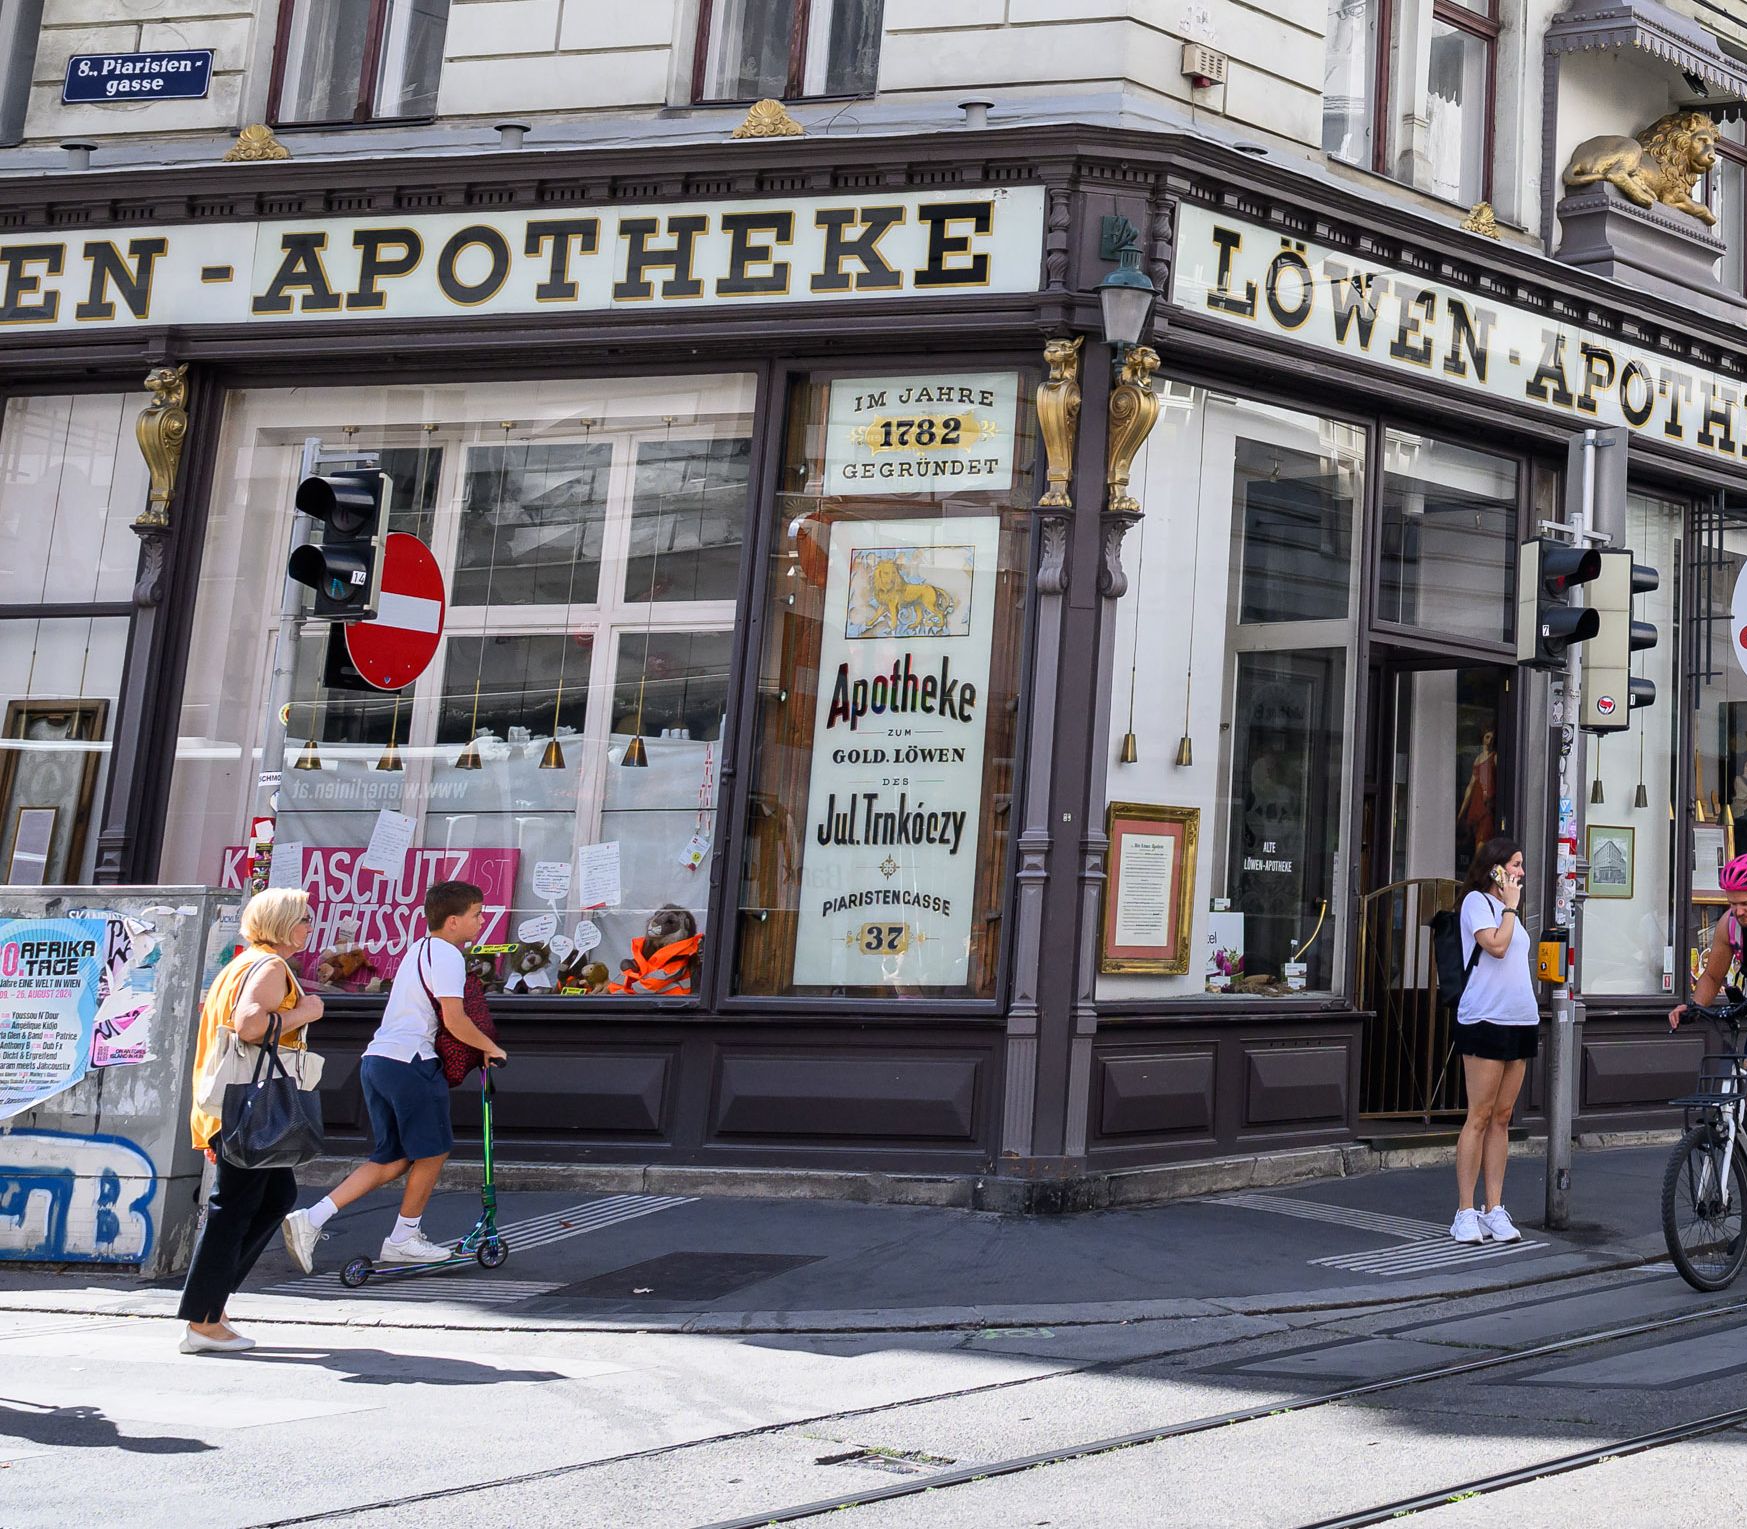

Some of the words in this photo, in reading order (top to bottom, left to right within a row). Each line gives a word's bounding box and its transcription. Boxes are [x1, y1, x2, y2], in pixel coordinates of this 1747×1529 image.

[106, 78, 164, 96] gasse
[854, 391, 887, 412] IM
[898, 386, 994, 407] JAHRE
[879, 417, 962, 447] 1782
[843, 457, 999, 479] GEGRÜNDET
[826, 653, 977, 731] Apotheke
[832, 749, 890, 764] GOLD.
[893, 745, 966, 764] LÖWEN
[882, 777, 909, 786] DES
[1263, 842, 1276, 853] ALTE
[1243, 856, 1293, 873] LÖWEN-APOTHEKE
[473, 859, 511, 896] IST
[822, 889, 951, 918] PIARISTENGASSE
[864, 925, 904, 952] 37
[20, 940, 97, 959] AFRIKA
[26, 958, 79, 976] TAGE
[18, 979, 35, 988] EINE
[35, 979, 54, 988] WELT
[54, 978, 63, 988] IN
[63, 978, 81, 988] WIEN
[27, 990, 54, 999] AUGUST
[54, 989, 72, 998] 2024
[12, 1011, 38, 1020] Youssou
